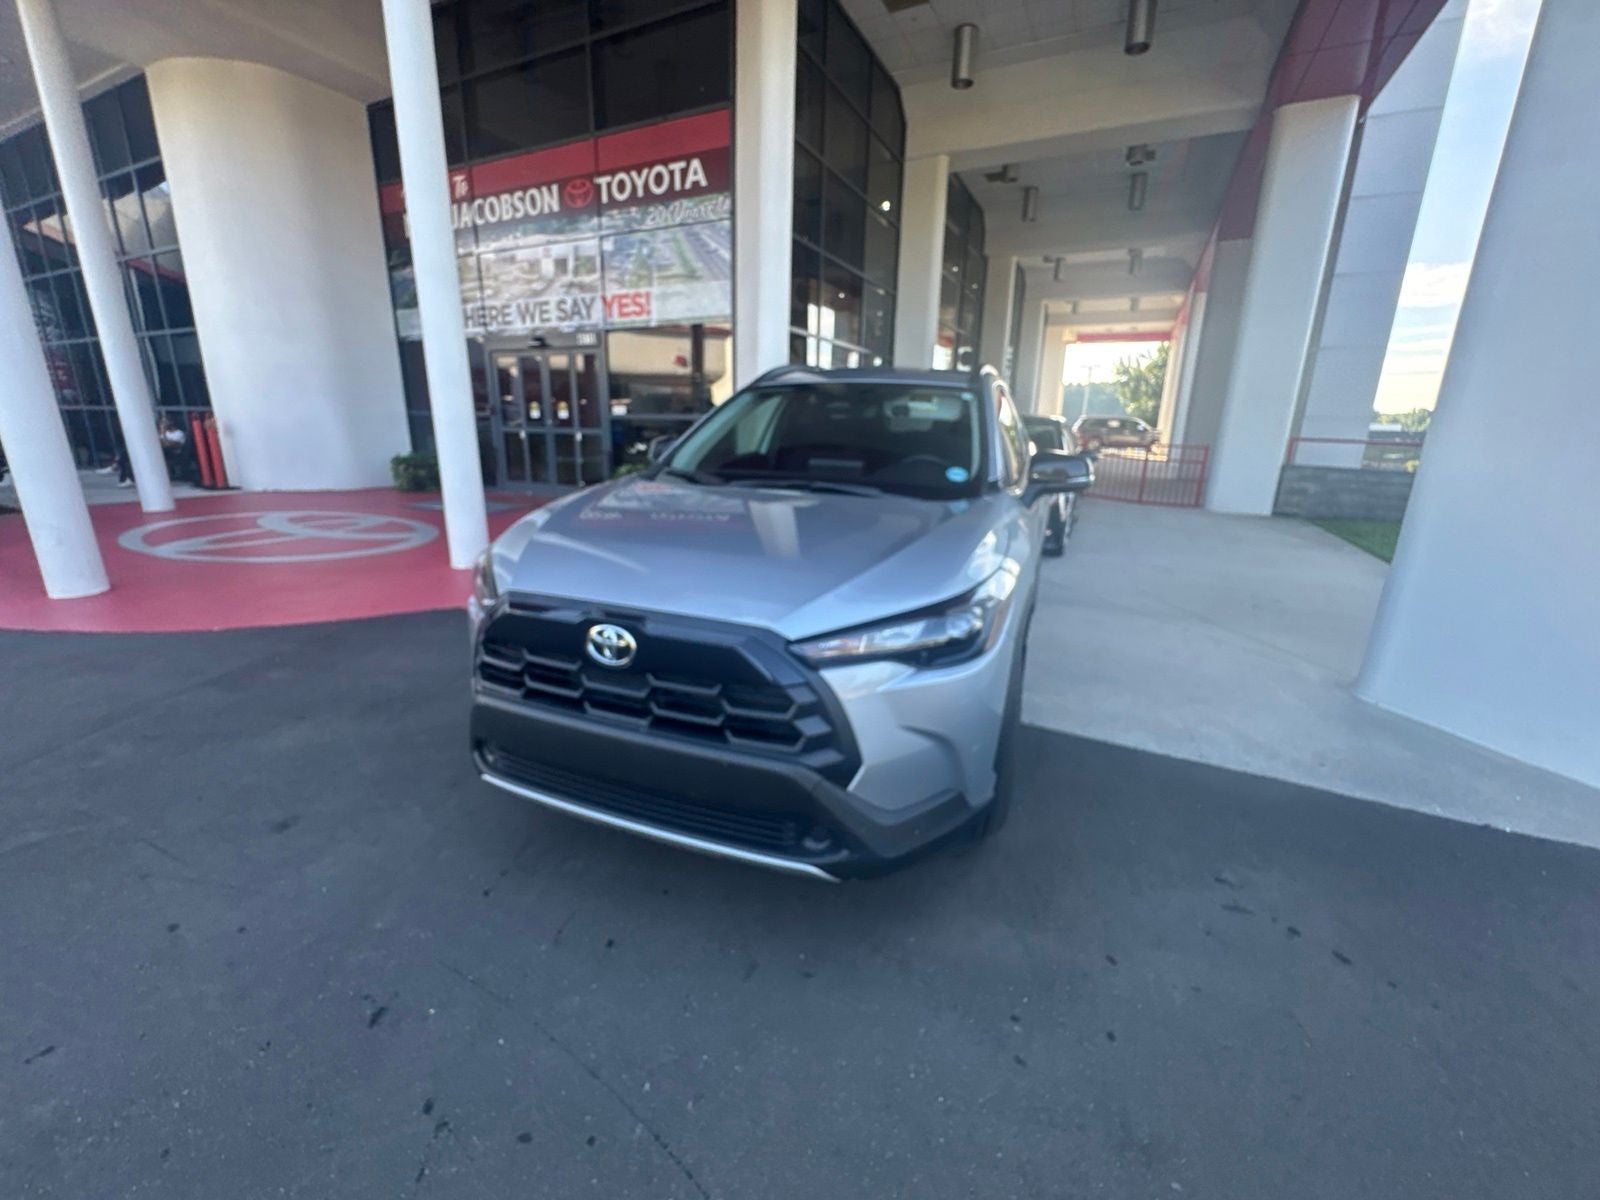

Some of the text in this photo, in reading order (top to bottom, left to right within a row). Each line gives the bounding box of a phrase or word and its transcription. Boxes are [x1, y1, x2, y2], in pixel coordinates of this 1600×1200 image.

[453, 158, 708, 229] JACOBSON TOYOTA
[516, 300, 552, 325] WE
[556, 295, 597, 321] SAY
[600, 291, 652, 319] YES!
